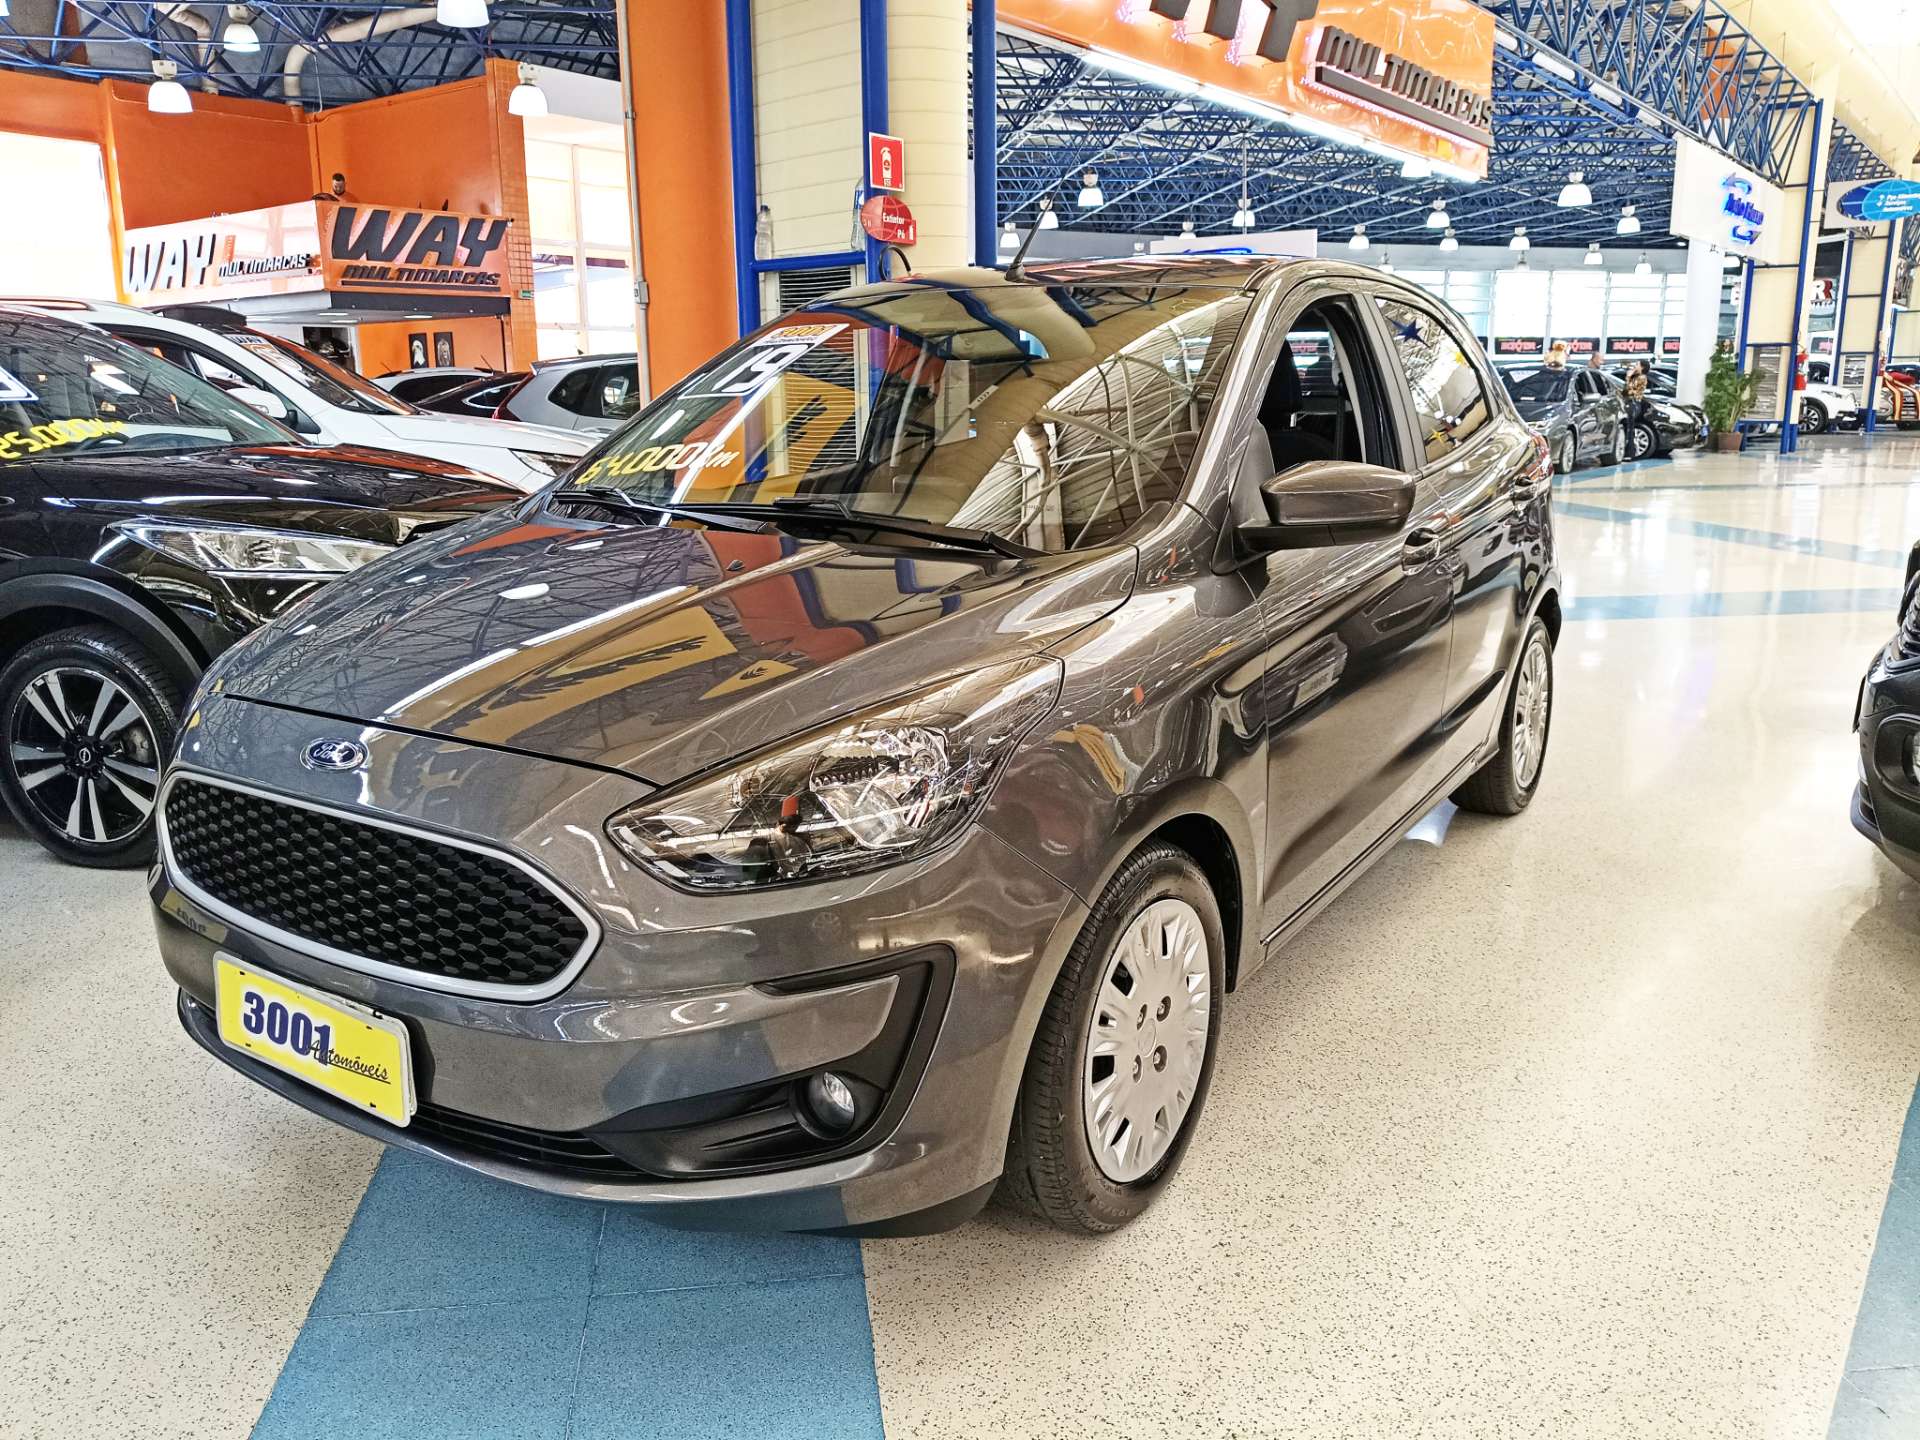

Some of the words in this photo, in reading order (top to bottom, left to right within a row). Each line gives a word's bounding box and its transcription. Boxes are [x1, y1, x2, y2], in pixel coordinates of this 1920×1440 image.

[1316, 26, 1495, 132] MULTIMARCAS
[127, 233, 216, 292] WAY
[219, 253, 312, 277] MULTIMARCAS
[331, 206, 508, 267] WAY
[341, 264, 501, 286] MULTIMARCAS
[312, 742, 350, 761] Ford
[243, 990, 331, 1067] 3001
